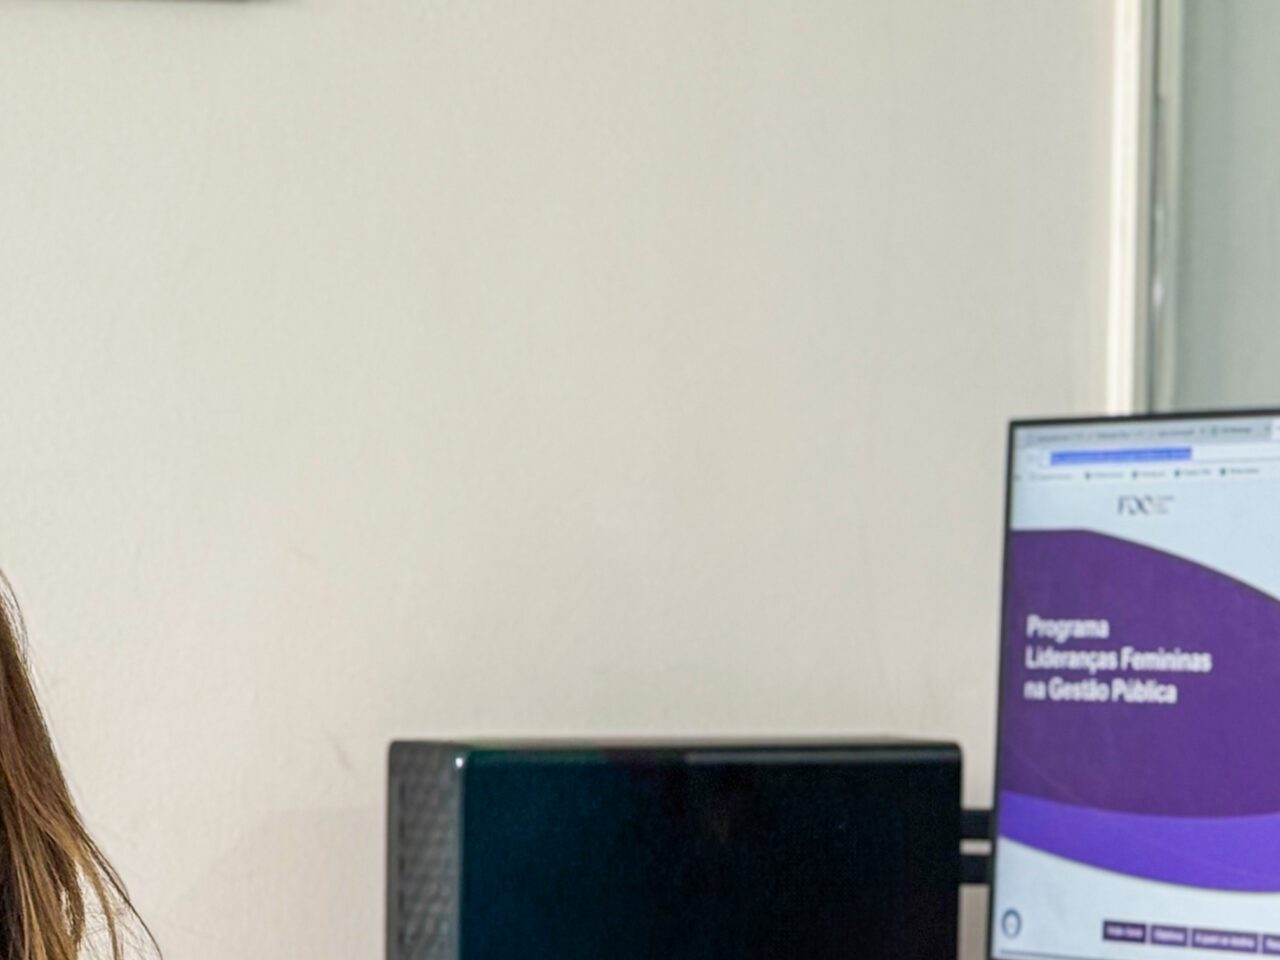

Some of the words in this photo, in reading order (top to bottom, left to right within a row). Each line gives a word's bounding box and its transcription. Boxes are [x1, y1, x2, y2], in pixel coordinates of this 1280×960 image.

[1026, 614, 1109, 643] Programa
[1025, 646, 1118, 674] Lideranças
[1121, 647, 1212, 672] Femininas
[1024, 681, 1046, 700] na
[1048, 676, 1110, 701] Gestão
[1111, 677, 1178, 704] Pública
